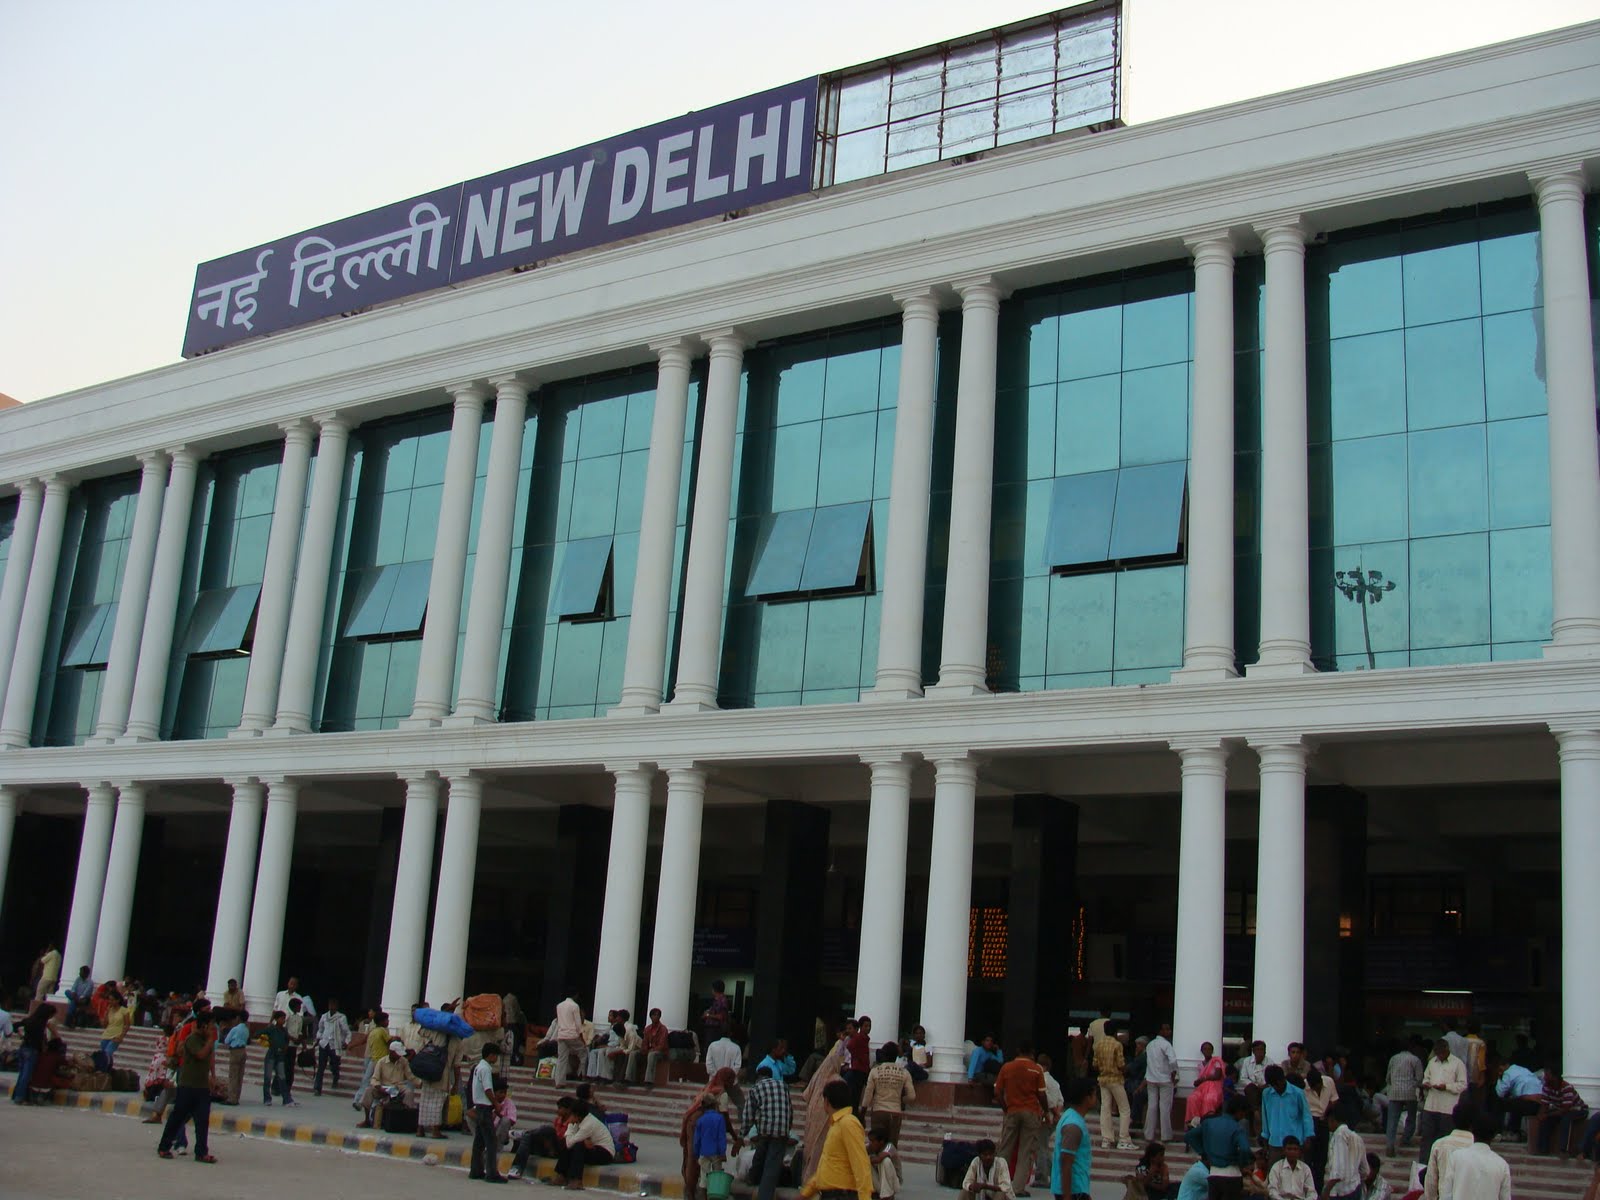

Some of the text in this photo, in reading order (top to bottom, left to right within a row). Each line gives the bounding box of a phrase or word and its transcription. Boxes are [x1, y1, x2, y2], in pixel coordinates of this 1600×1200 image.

[460, 97, 805, 265] NEW DELHI
[197, 201, 451, 331] नई दिल्ली
